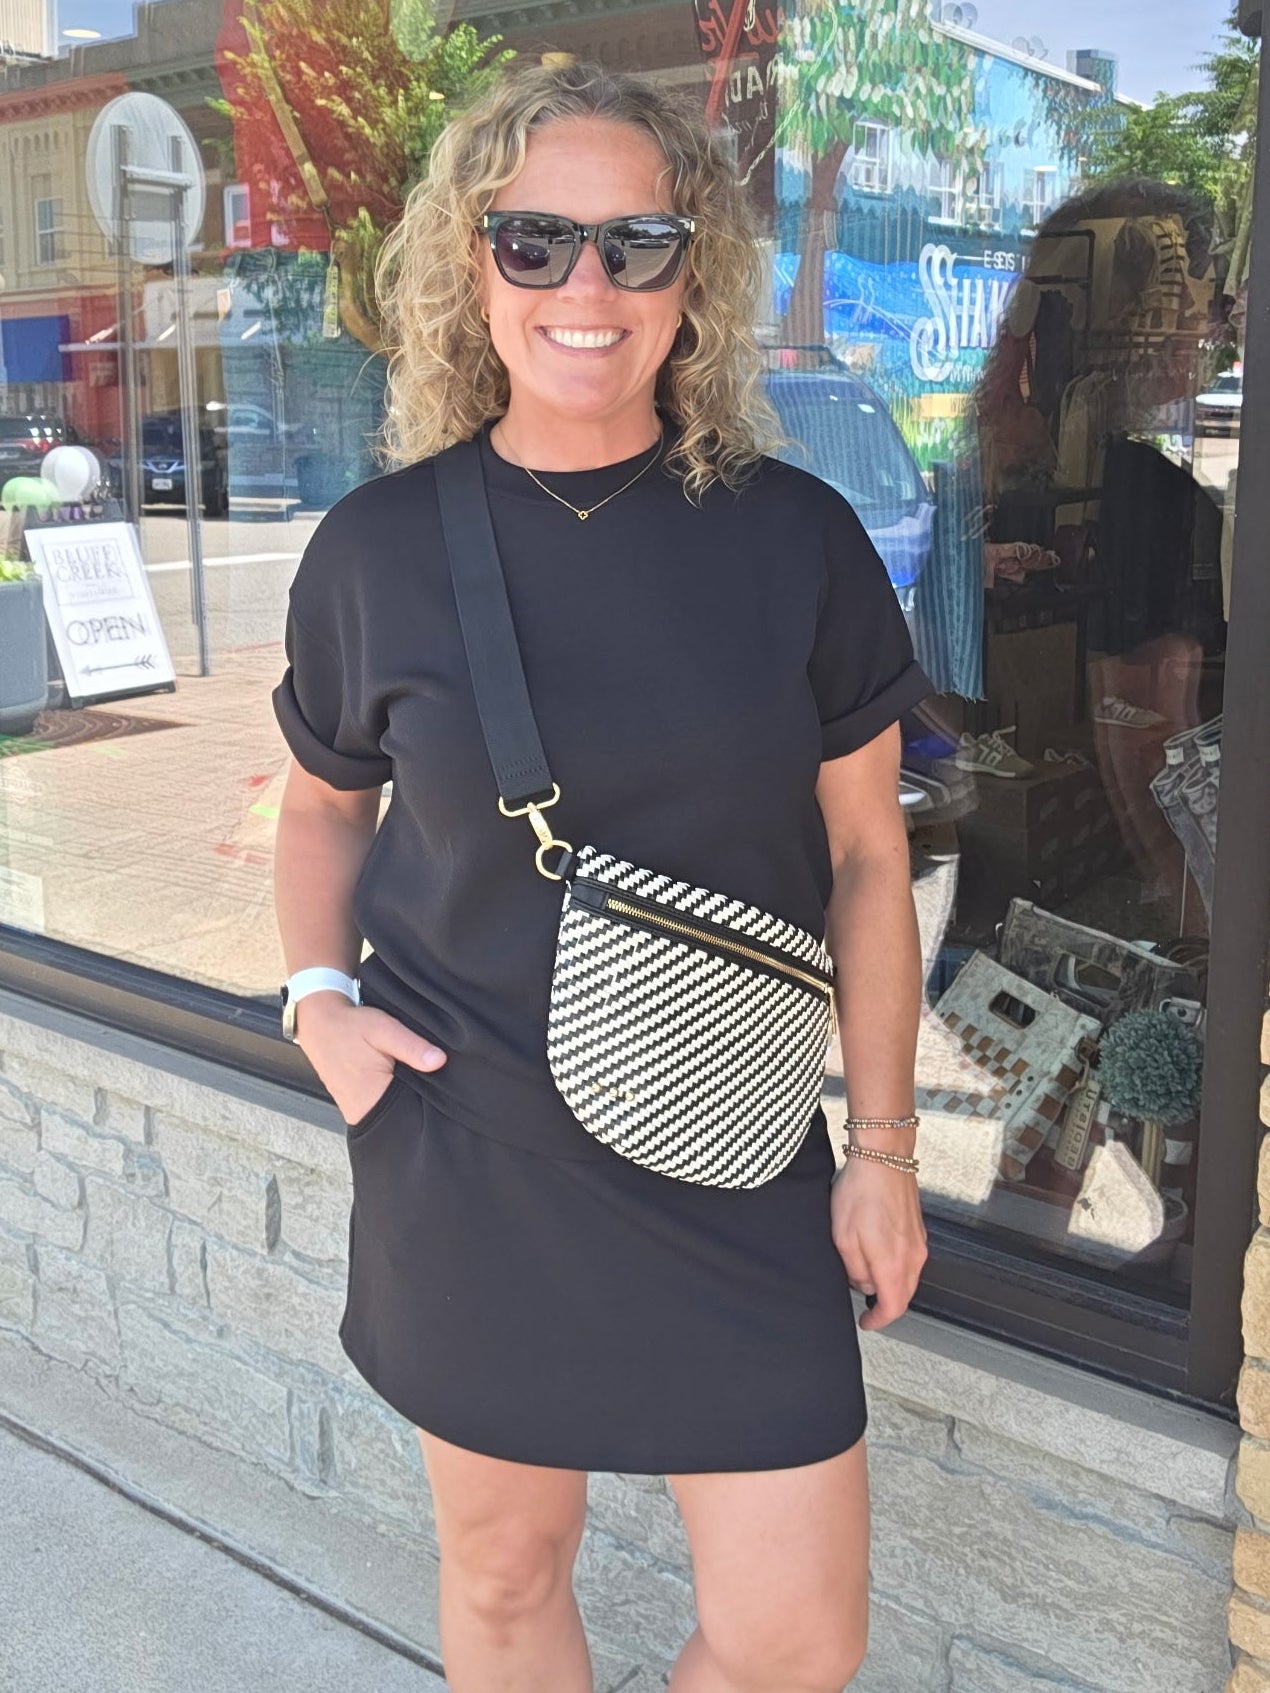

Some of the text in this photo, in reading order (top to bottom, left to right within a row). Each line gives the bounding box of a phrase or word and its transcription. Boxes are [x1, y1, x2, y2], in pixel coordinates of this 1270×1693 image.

[52, 543, 116, 565] BLUFF
[56, 562, 123, 583] CREEK
[66, 613, 147, 646] OPEN
